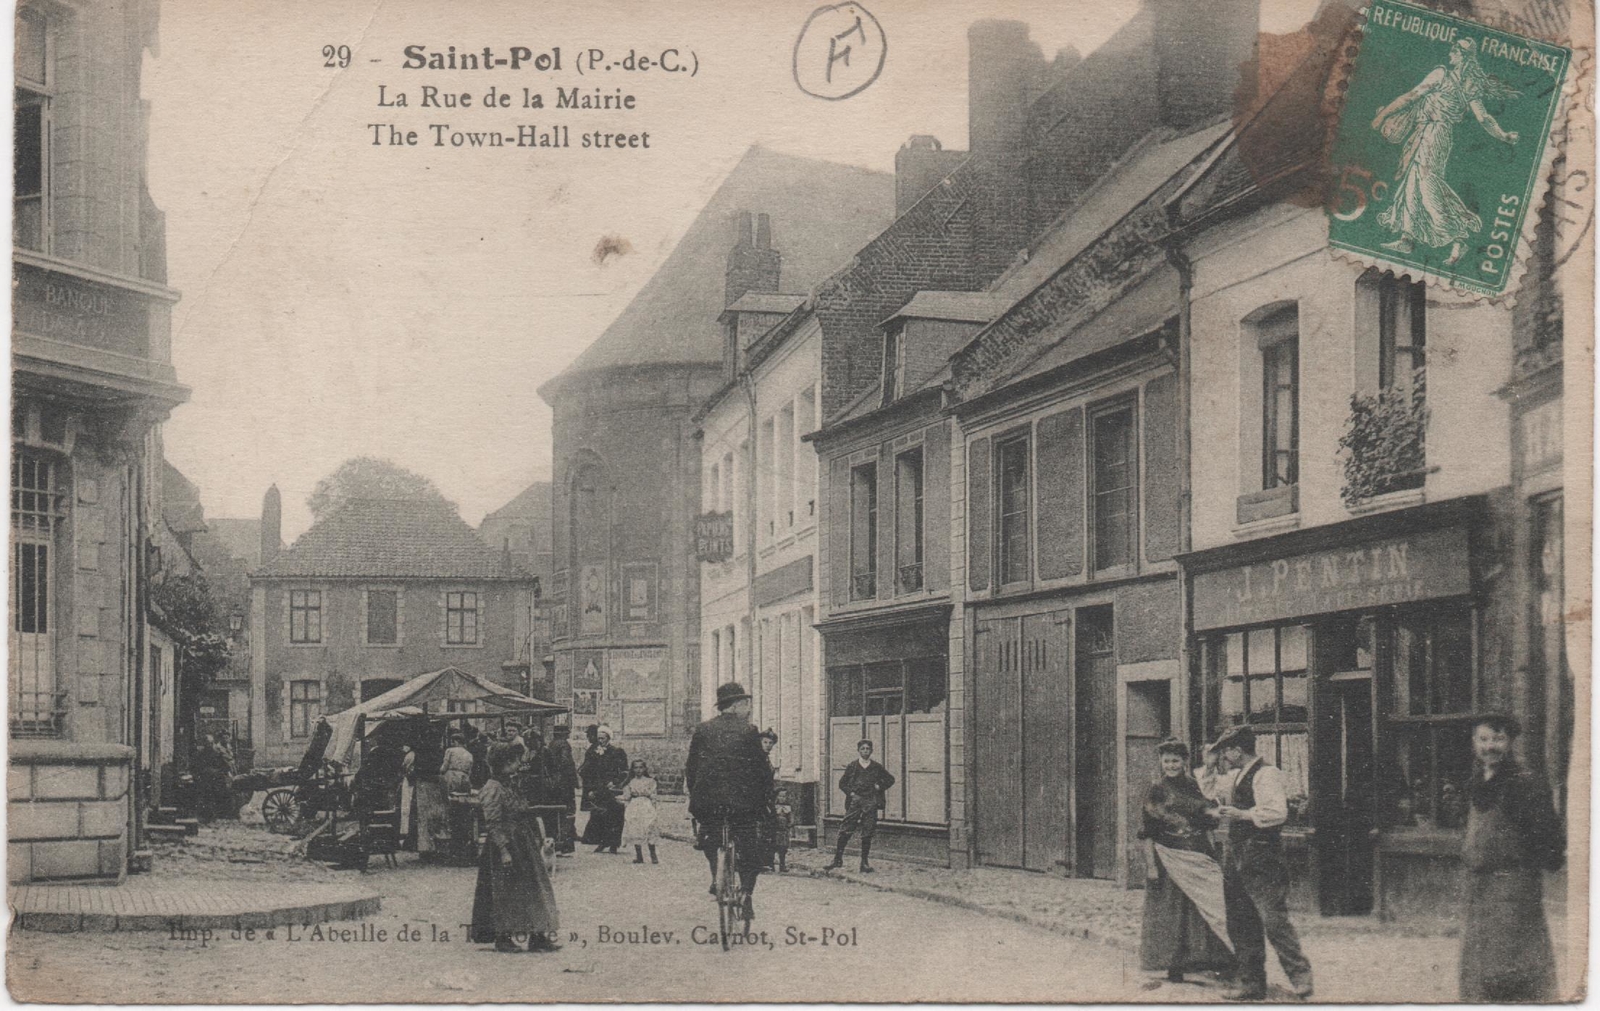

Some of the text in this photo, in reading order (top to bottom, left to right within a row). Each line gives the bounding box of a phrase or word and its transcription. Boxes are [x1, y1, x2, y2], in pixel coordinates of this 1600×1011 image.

[1481, 36, 1559, 72] FRANÇAISE
[1481, 193, 1520, 274] POSTES
[45, 283, 116, 317] BANQUE
[1271, 541, 1410, 595] PENTIN
